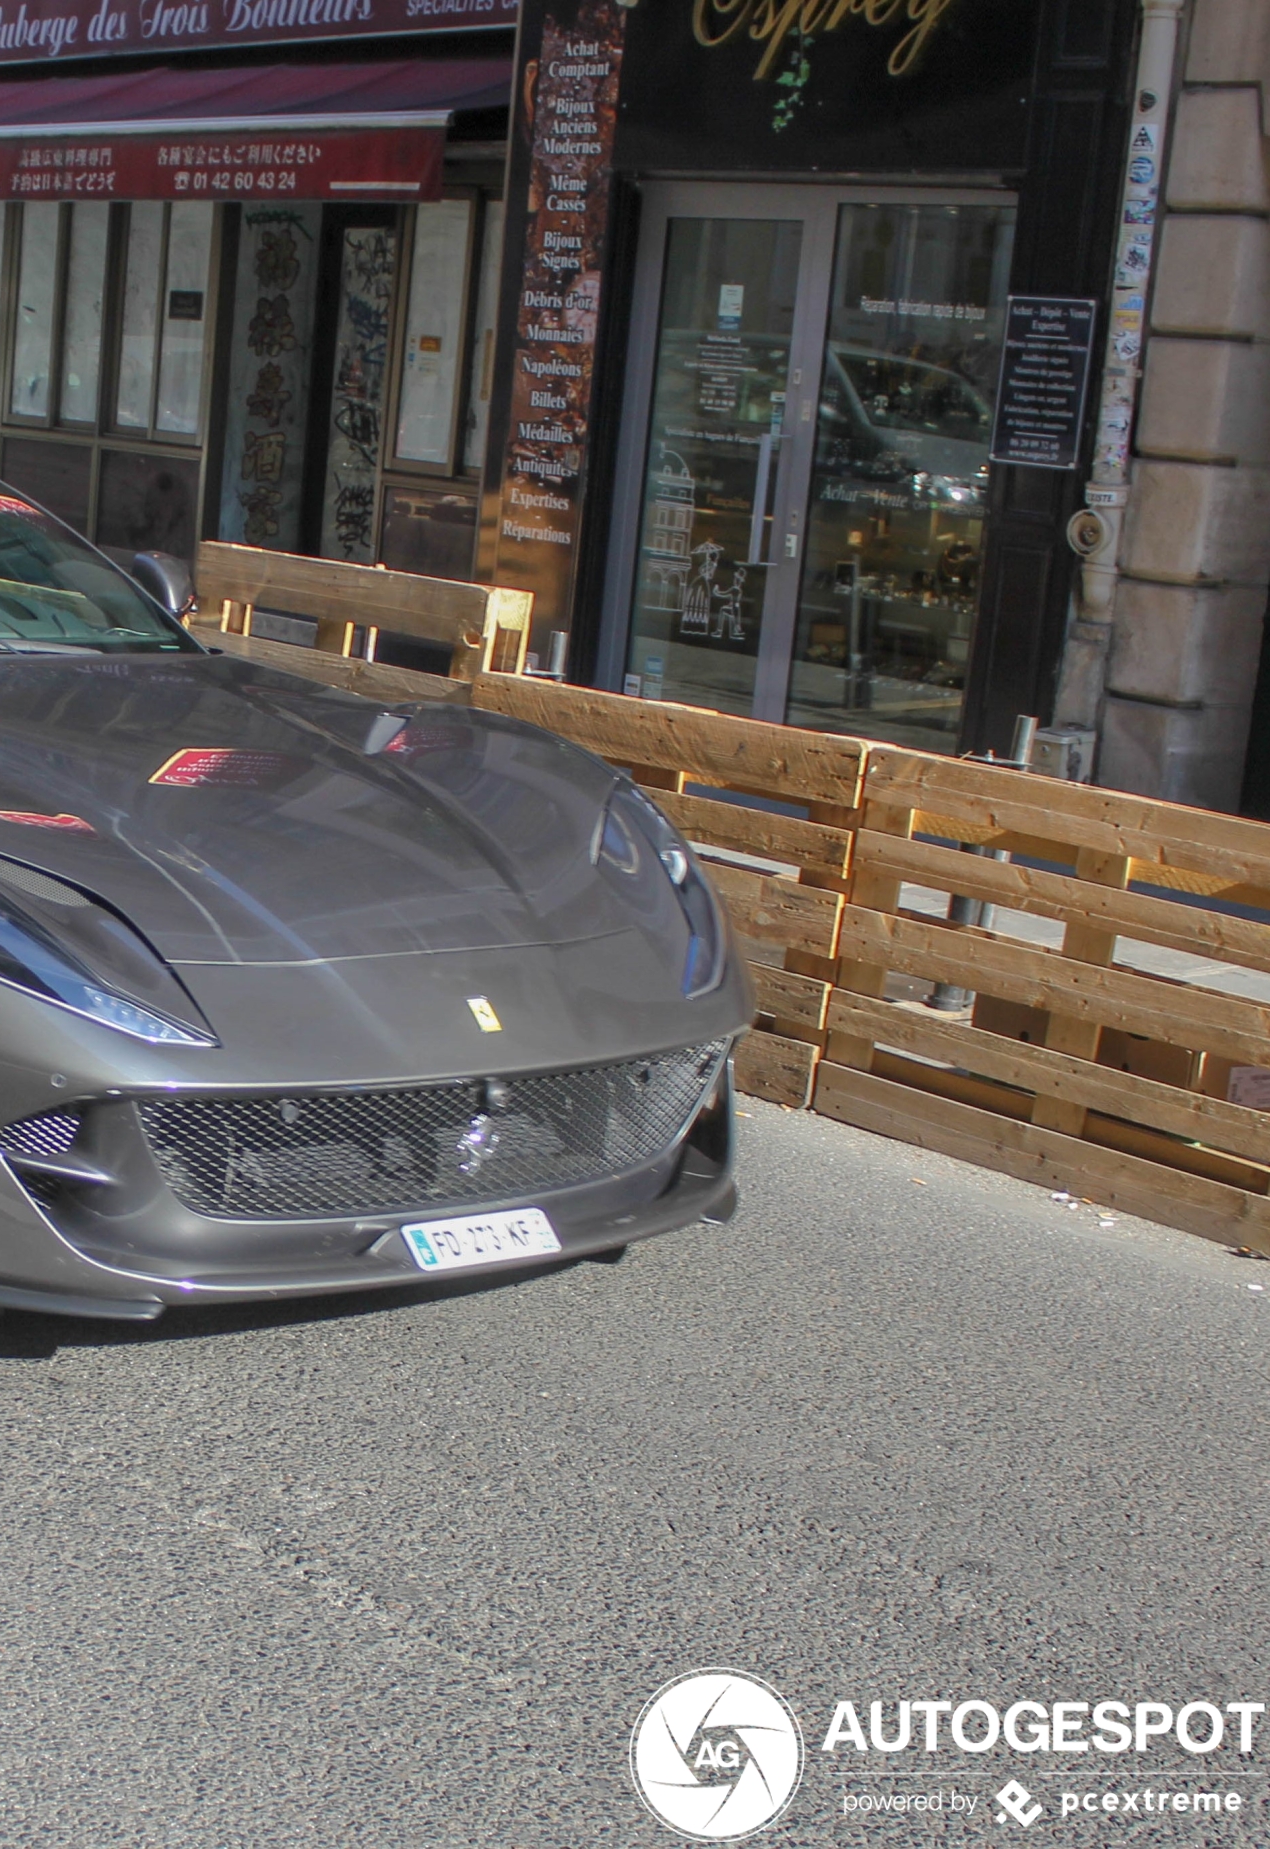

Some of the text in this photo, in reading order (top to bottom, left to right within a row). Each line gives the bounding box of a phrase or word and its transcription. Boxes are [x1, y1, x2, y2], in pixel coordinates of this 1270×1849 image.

[87, 0, 127, 42] des
[139, 0, 210, 39] Trois
[563, 40, 599, 57] Achat
[549, 61, 610, 80] Comptant
[556, 98, 595, 118] Bijoux
[550, 118, 597, 134] Anciens
[543, 138, 602, 155] Modernes
[193, 172, 296, 190] 01 42 60 43 24
[550, 174, 587, 191] Même
[546, 195, 586, 211] Cassés
[543, 231, 582, 251] Bijoux
[542, 252, 580, 272] Signés
[524, 290, 562, 308] Débris
[526, 324, 584, 343] Monnaies
[522, 357, 582, 378] Napoléons
[531, 391, 567, 409] Billets
[518, 423, 573, 443] Médailles
[513, 456, 572, 478] Antiquités
[510, 488, 569, 510] Expertises
[820, 485, 857, 502] Achat
[502, 520, 571, 544] Réparations
